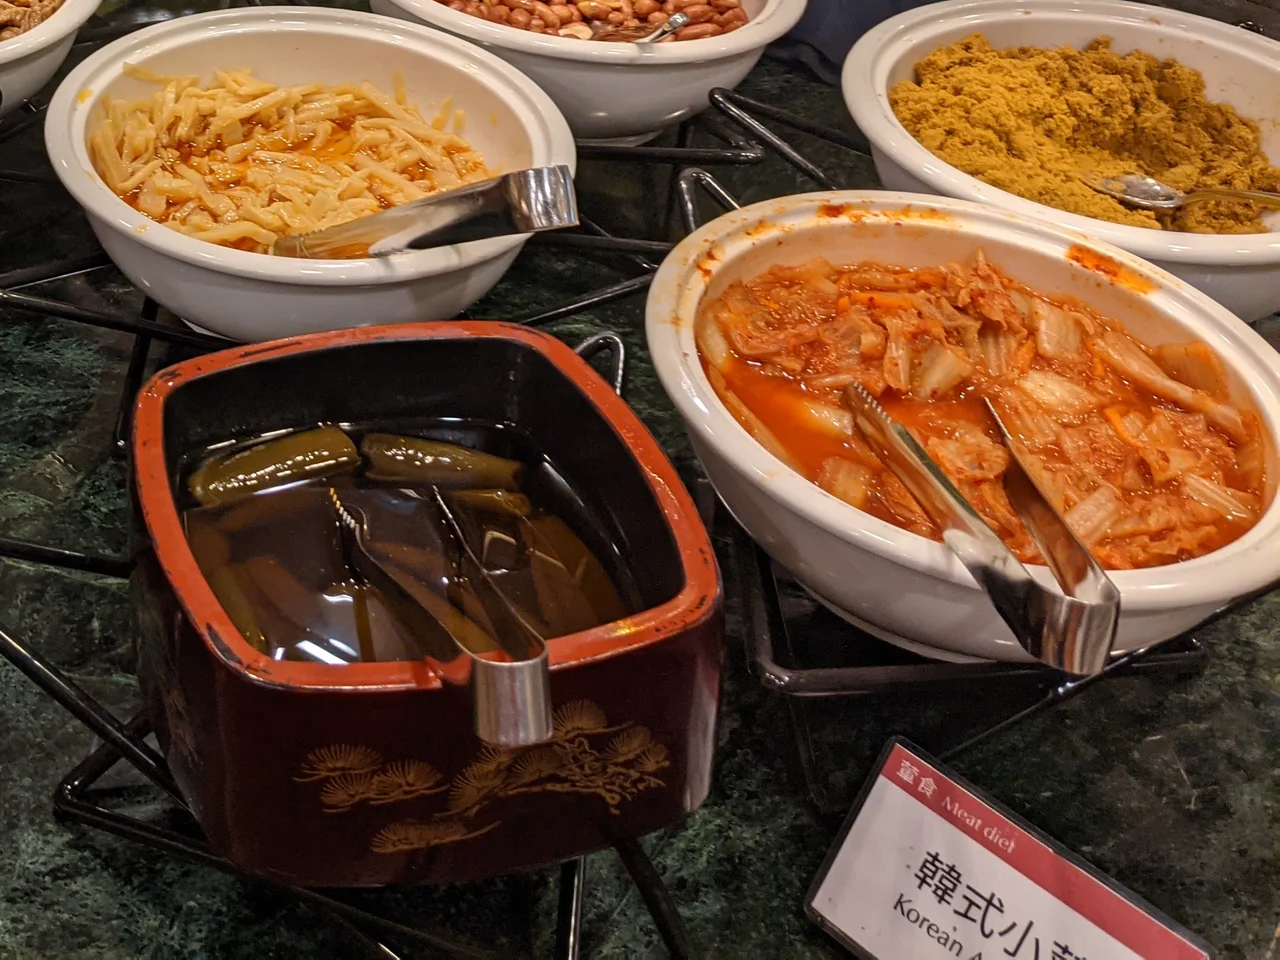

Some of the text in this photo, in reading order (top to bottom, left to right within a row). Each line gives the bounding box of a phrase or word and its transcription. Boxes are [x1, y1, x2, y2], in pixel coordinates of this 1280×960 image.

[896, 759, 1016, 855] 葷食 Meat diet
[893, 893, 964, 958] Korean
